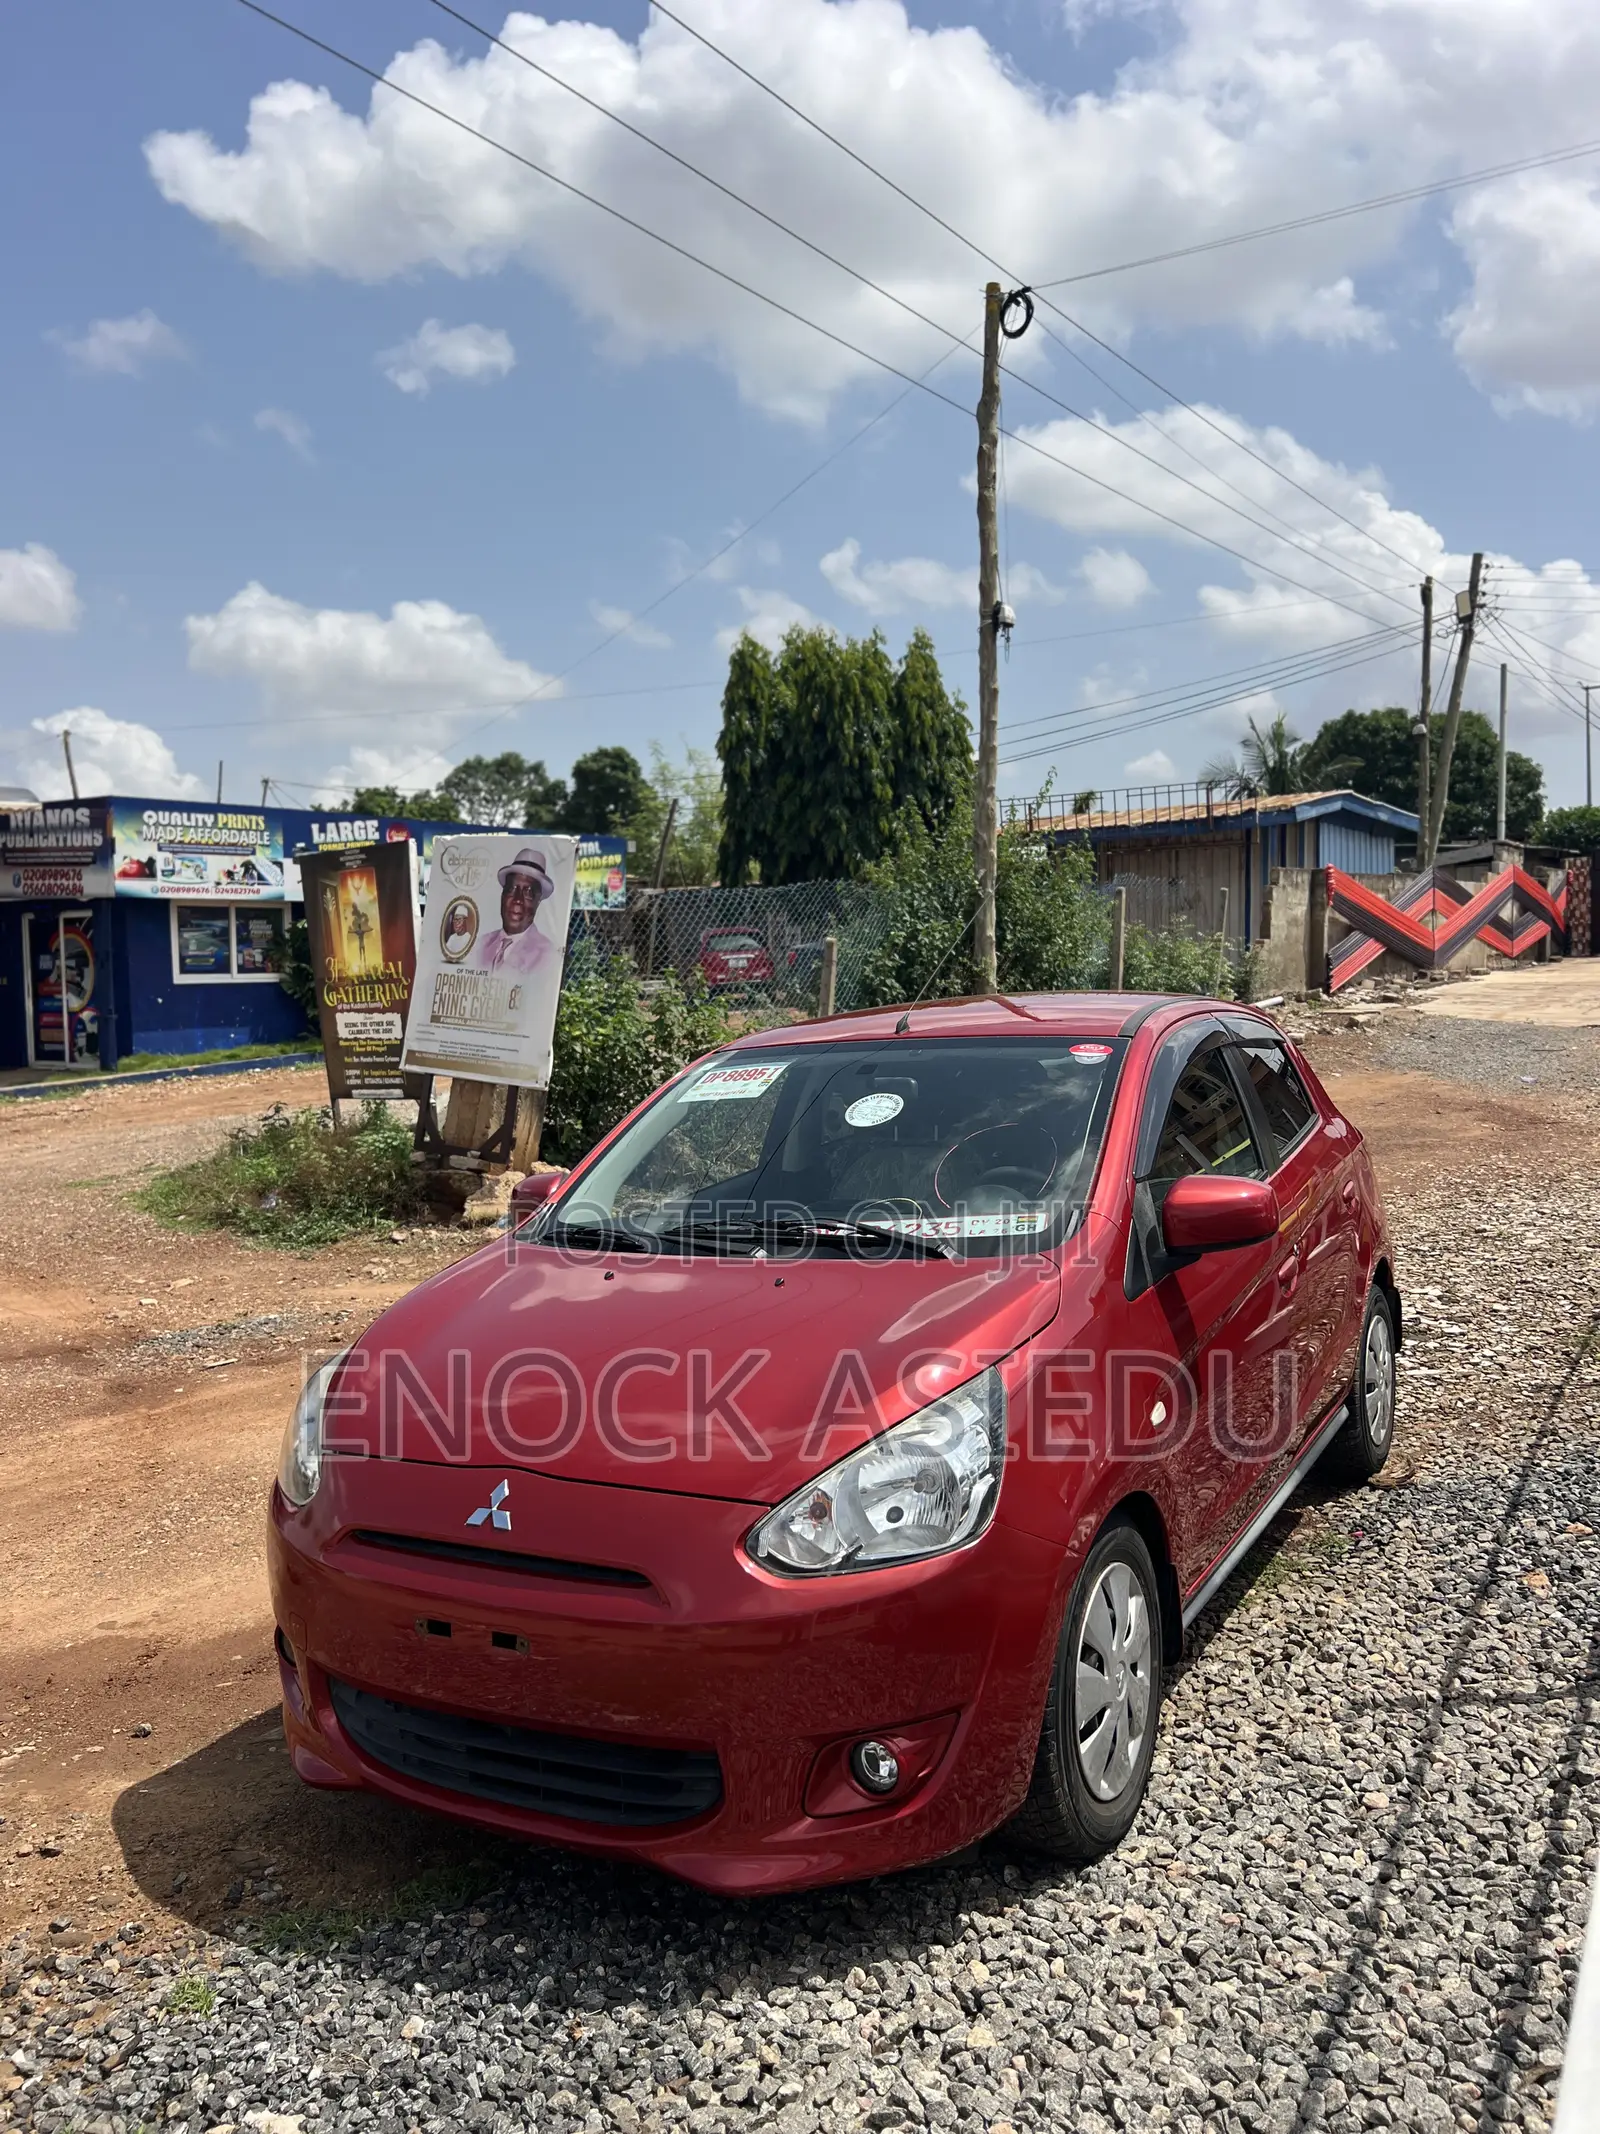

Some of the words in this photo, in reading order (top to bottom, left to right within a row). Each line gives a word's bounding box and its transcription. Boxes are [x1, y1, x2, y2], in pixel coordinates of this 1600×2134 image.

[142, 810, 215, 828] QUALITY
[217, 813, 265, 830] PRINTS
[0, 829, 104, 848] PUBLICATIONS
[142, 825, 184, 841] MADE
[184, 826, 271, 845] AFFORDABLE
[311, 820, 380, 844] LARGE
[23, 868, 83, 881] 0208989676
[23, 883, 84, 897] 0560809684
[160, 886, 210, 894] 0208989676
[435, 973, 480, 996] OPANYIN
[323, 983, 408, 1007] GATHERING
[1014, 1223, 1037, 1233] GH
